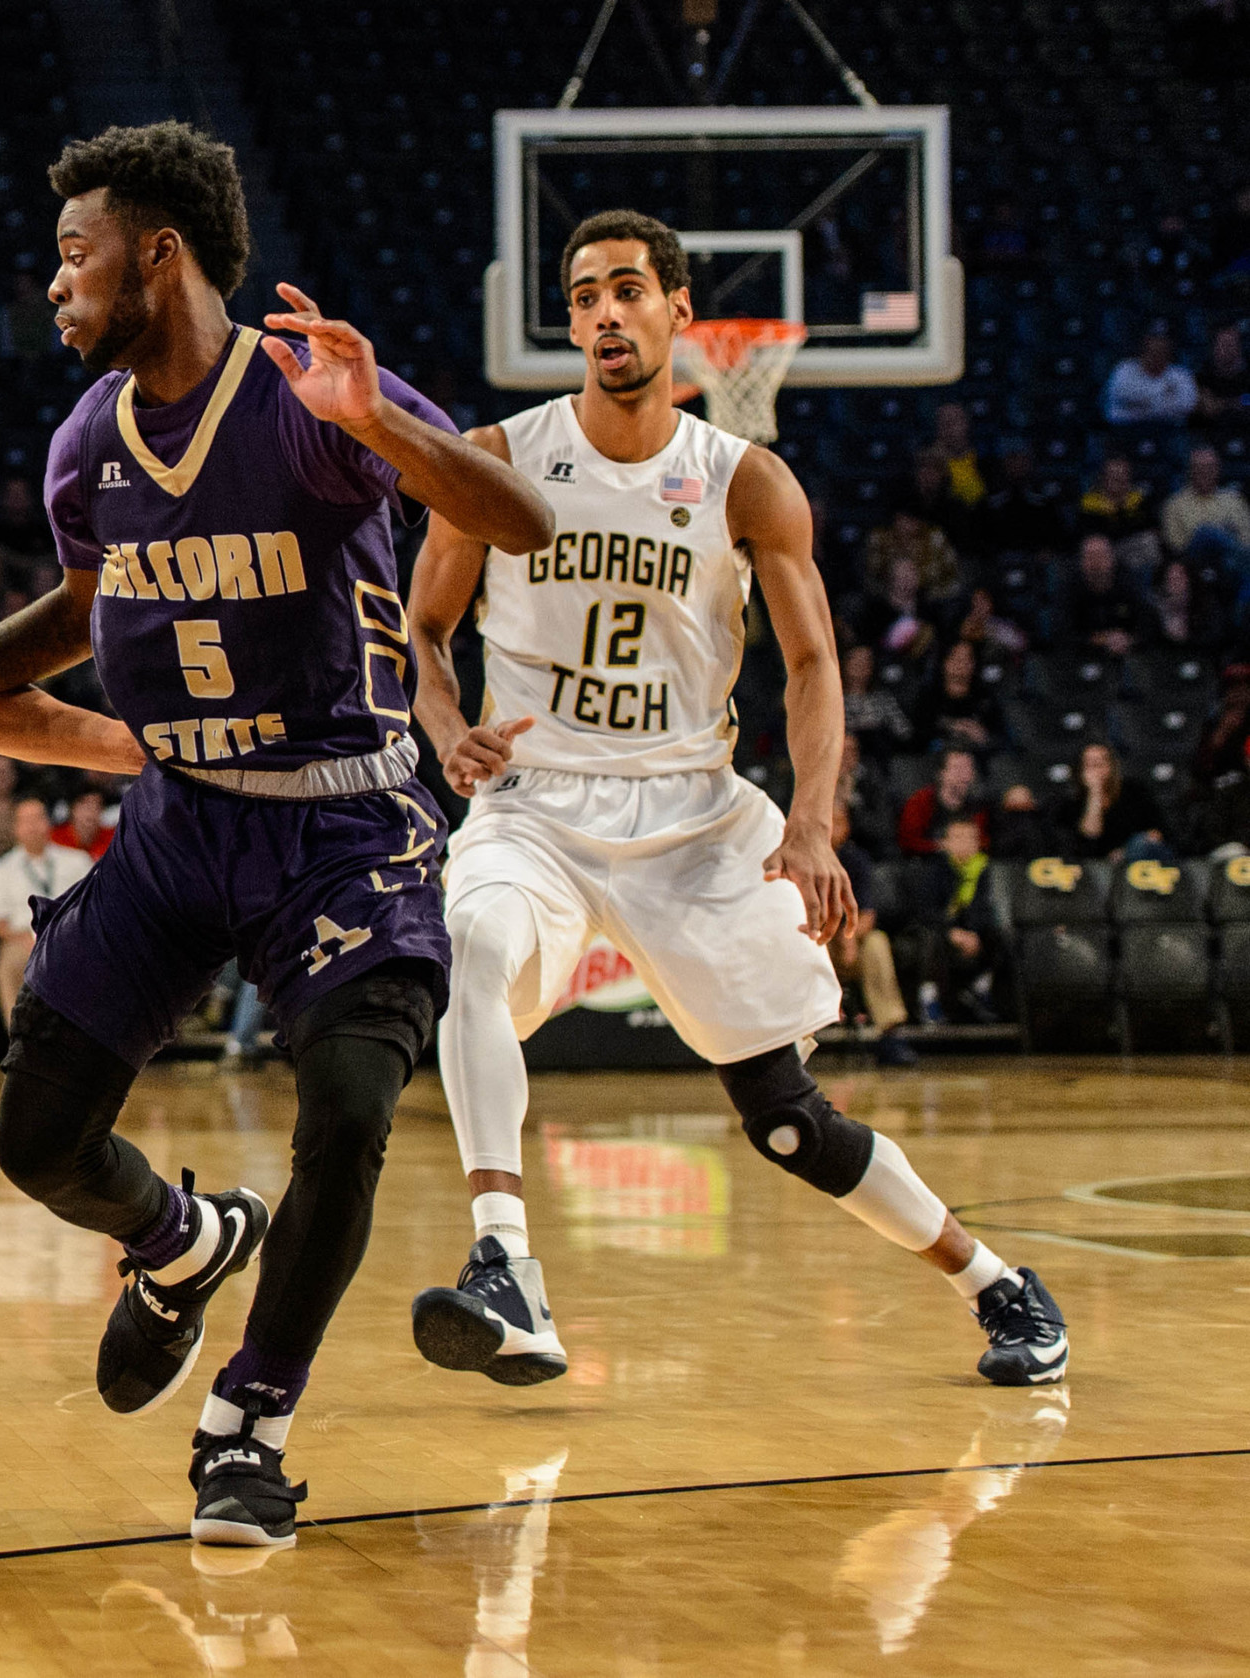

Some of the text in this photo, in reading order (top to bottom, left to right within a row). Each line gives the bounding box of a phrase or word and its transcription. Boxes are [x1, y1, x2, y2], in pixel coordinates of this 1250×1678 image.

[98, 480, 131, 489] RUSSELL
[100, 531, 307, 601] ALCORN
[527, 532, 693, 597] GEORGIA
[173, 619, 235, 699] 5
[581, 600, 646, 668] 12
[549, 662, 669, 731] TECH
[142, 713, 288, 763] STATE
